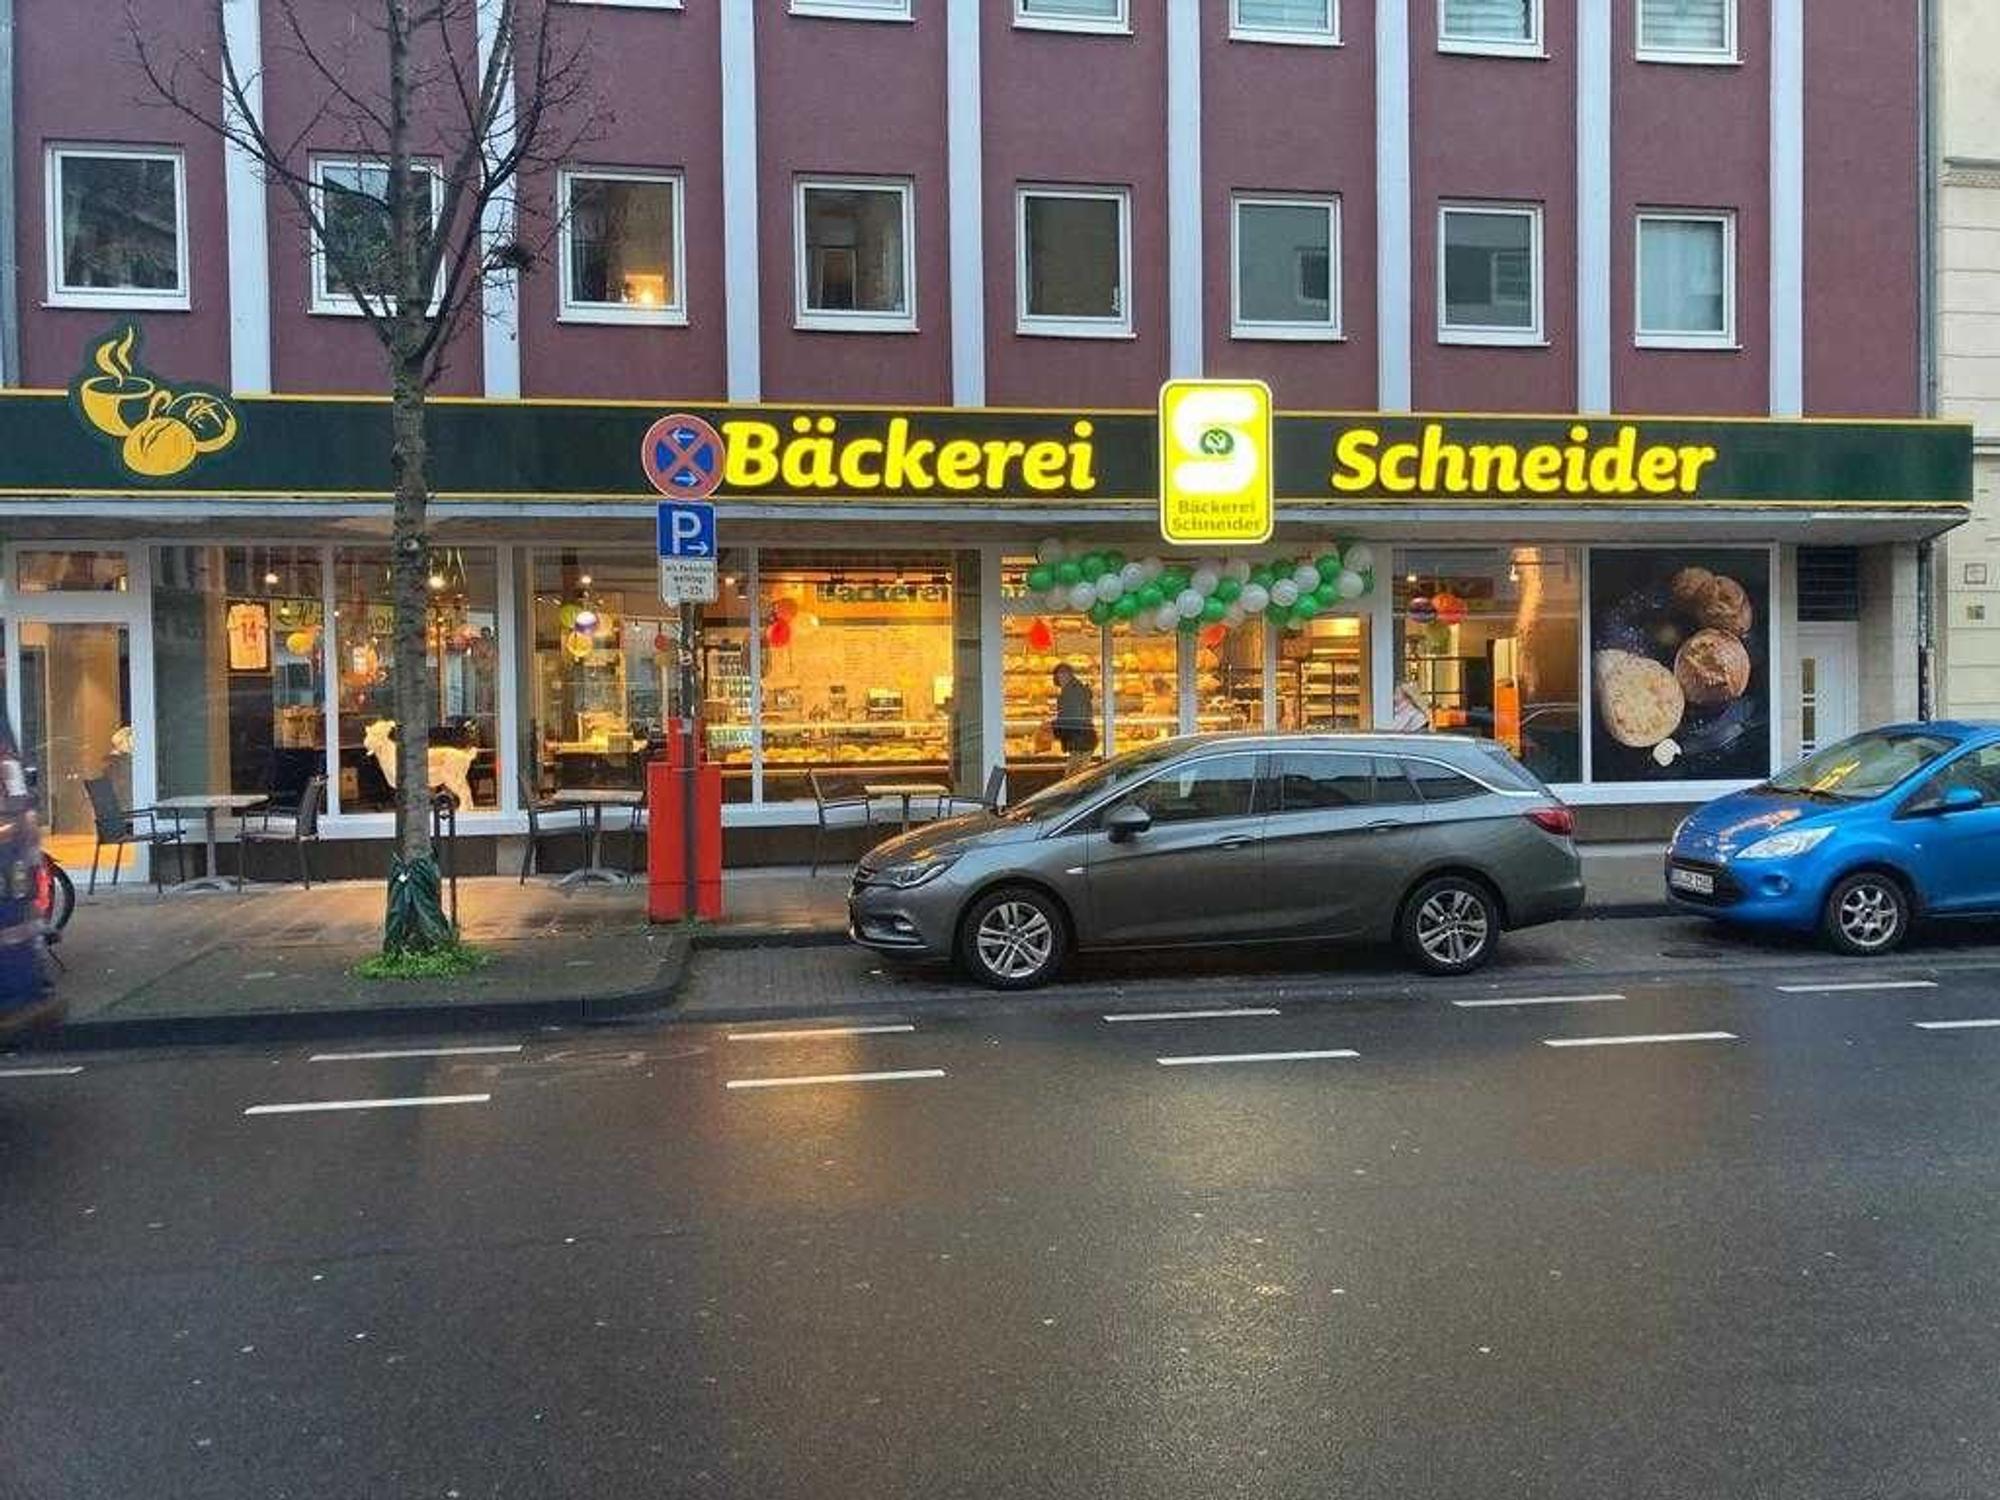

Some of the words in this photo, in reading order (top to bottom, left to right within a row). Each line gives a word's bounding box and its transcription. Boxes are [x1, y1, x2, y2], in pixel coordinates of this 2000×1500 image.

[722, 416, 1096, 490] Bäckerei
[1331, 424, 1717, 493] Schneider
[1172, 517, 1261, 531] Schneider
[1177, 500, 1256, 514] Bäckerei
[672, 511, 702, 554] P
